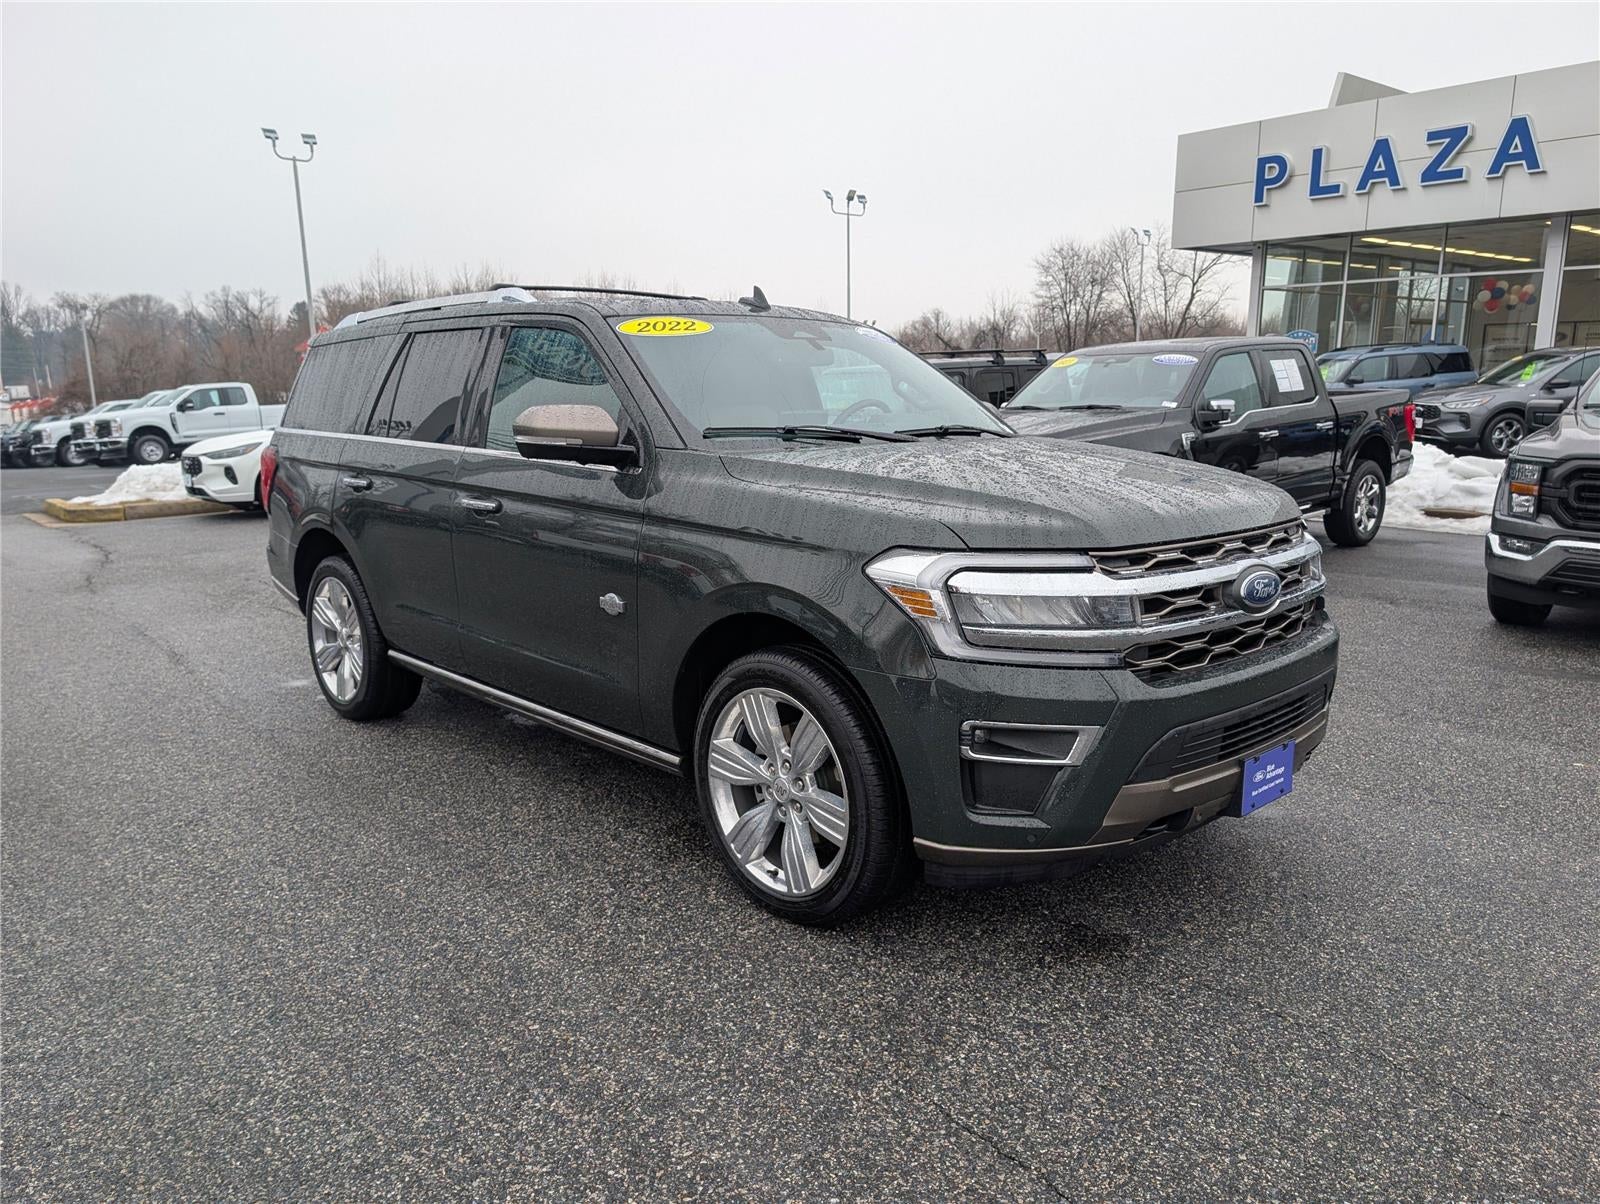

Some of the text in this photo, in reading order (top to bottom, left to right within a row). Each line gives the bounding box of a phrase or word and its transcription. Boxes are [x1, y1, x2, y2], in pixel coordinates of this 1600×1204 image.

[1253, 114, 1546, 206] PLAZA
[636, 320, 697, 333] 2022
[1253, 578, 1277, 598] Ford
[1266, 763, 1275, 772] Blue
[1266, 766, 1285, 780] Advantage
